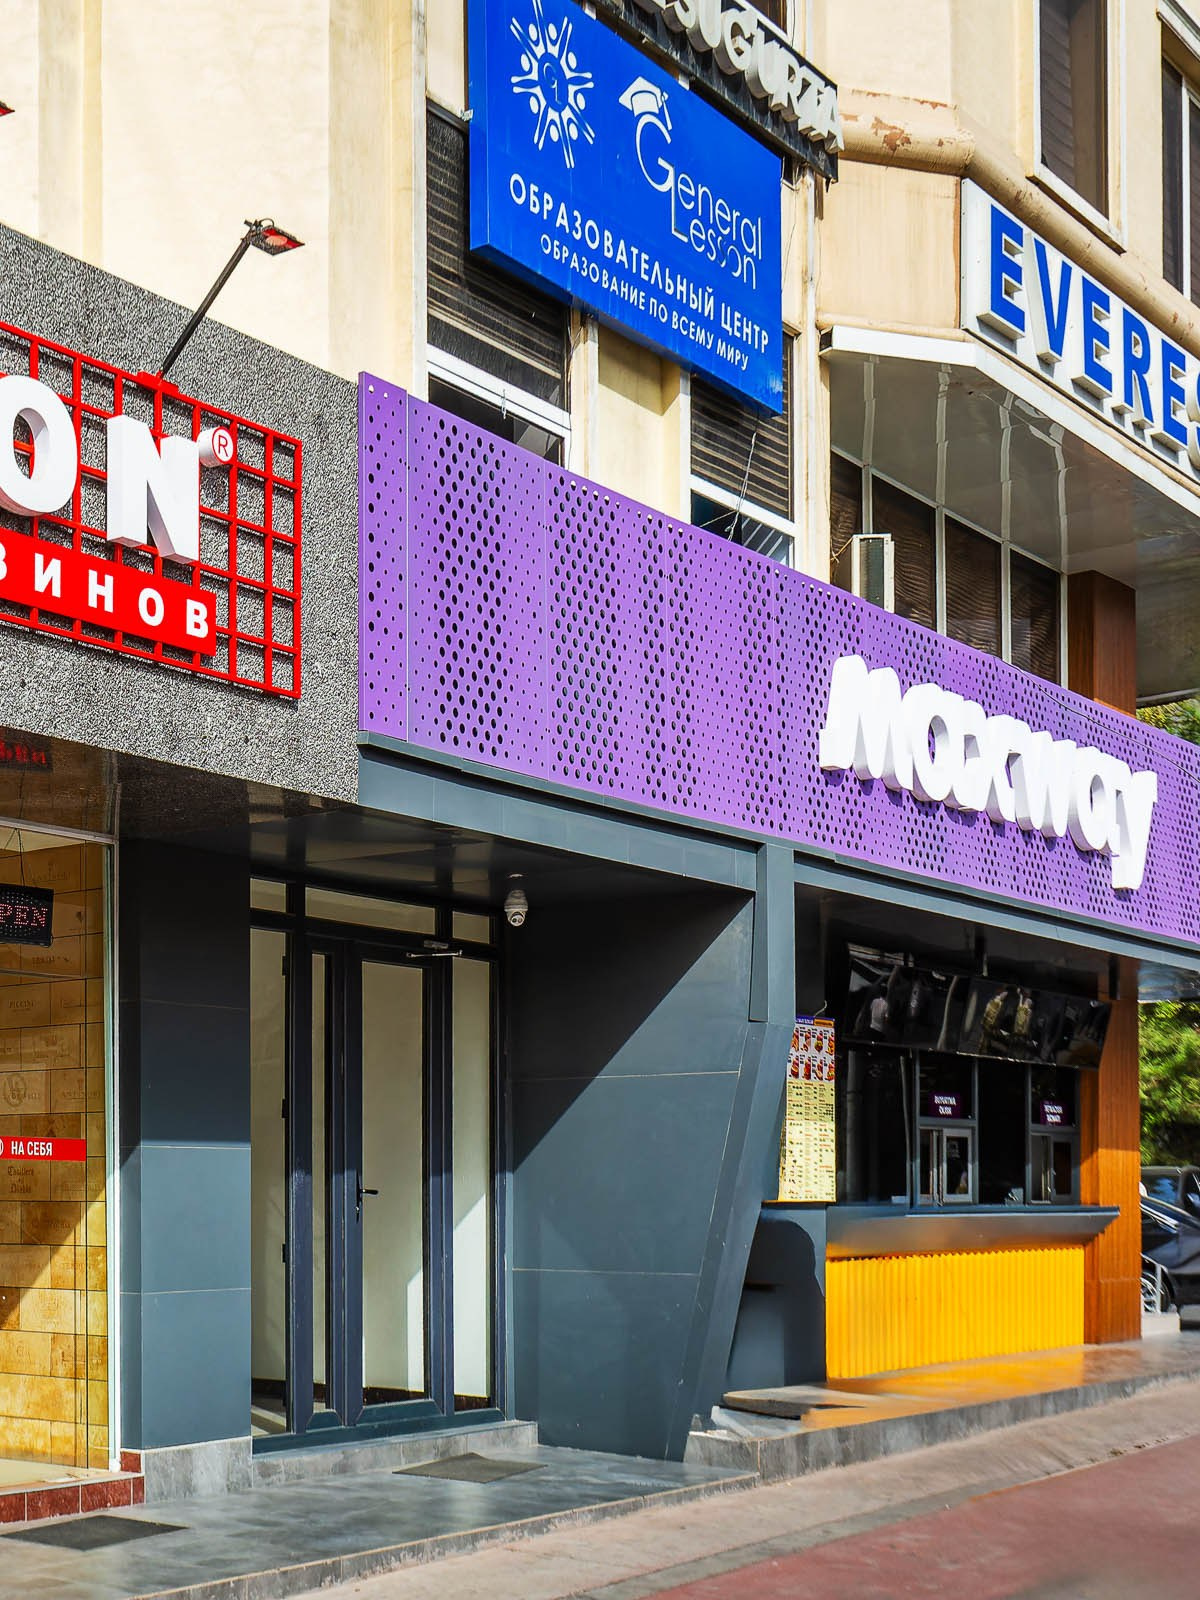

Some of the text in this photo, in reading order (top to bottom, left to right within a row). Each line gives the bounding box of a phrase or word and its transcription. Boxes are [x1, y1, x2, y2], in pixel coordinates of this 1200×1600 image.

[634, 113, 762, 260] General
[672, 195, 758, 290] Lesson
[509, 173, 770, 354] ОБРАЗОВАТЕЛЬНЫЙ ЦЕНТР
[540, 233, 750, 372] ОБРАЗОВАНИЕ ПО ВСЕМУ МИРУ
[976, 203, 1200, 470] EVERE
[11, 1140, 25, 1156] НА
[26, 1141, 53, 1157] СЕБЯ
